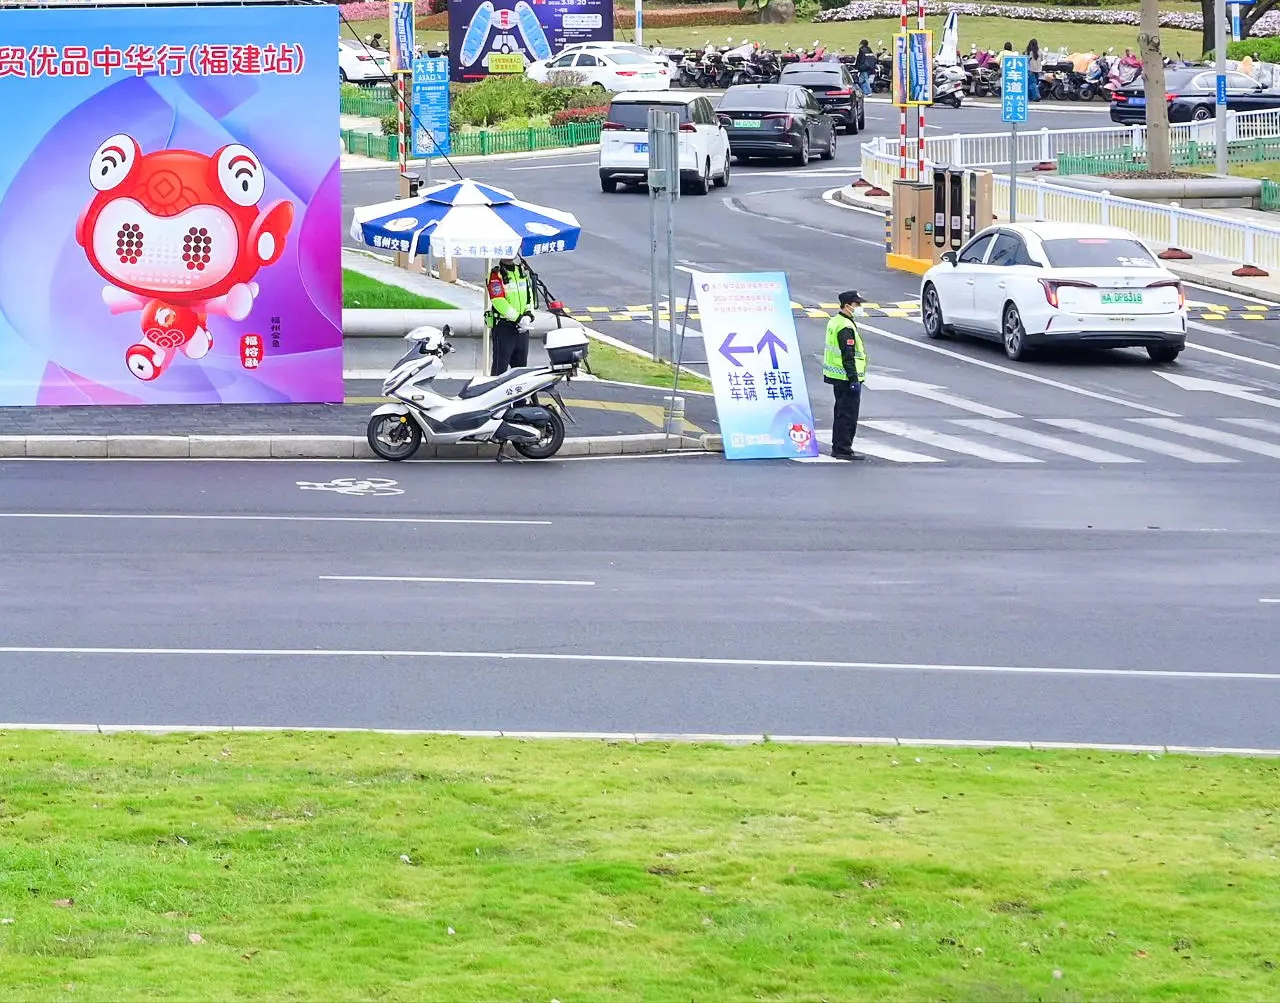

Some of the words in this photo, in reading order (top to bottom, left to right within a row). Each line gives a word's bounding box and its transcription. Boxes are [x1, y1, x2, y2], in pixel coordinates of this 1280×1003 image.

[416, 61, 446, 73] 大车道
[1006, 58, 1023, 93] 小车道
[728, 371, 755, 387] 社会
[763, 370, 792, 386] 持证
[730, 386, 758, 402] 车辆
[766, 385, 794, 401] 车辆
